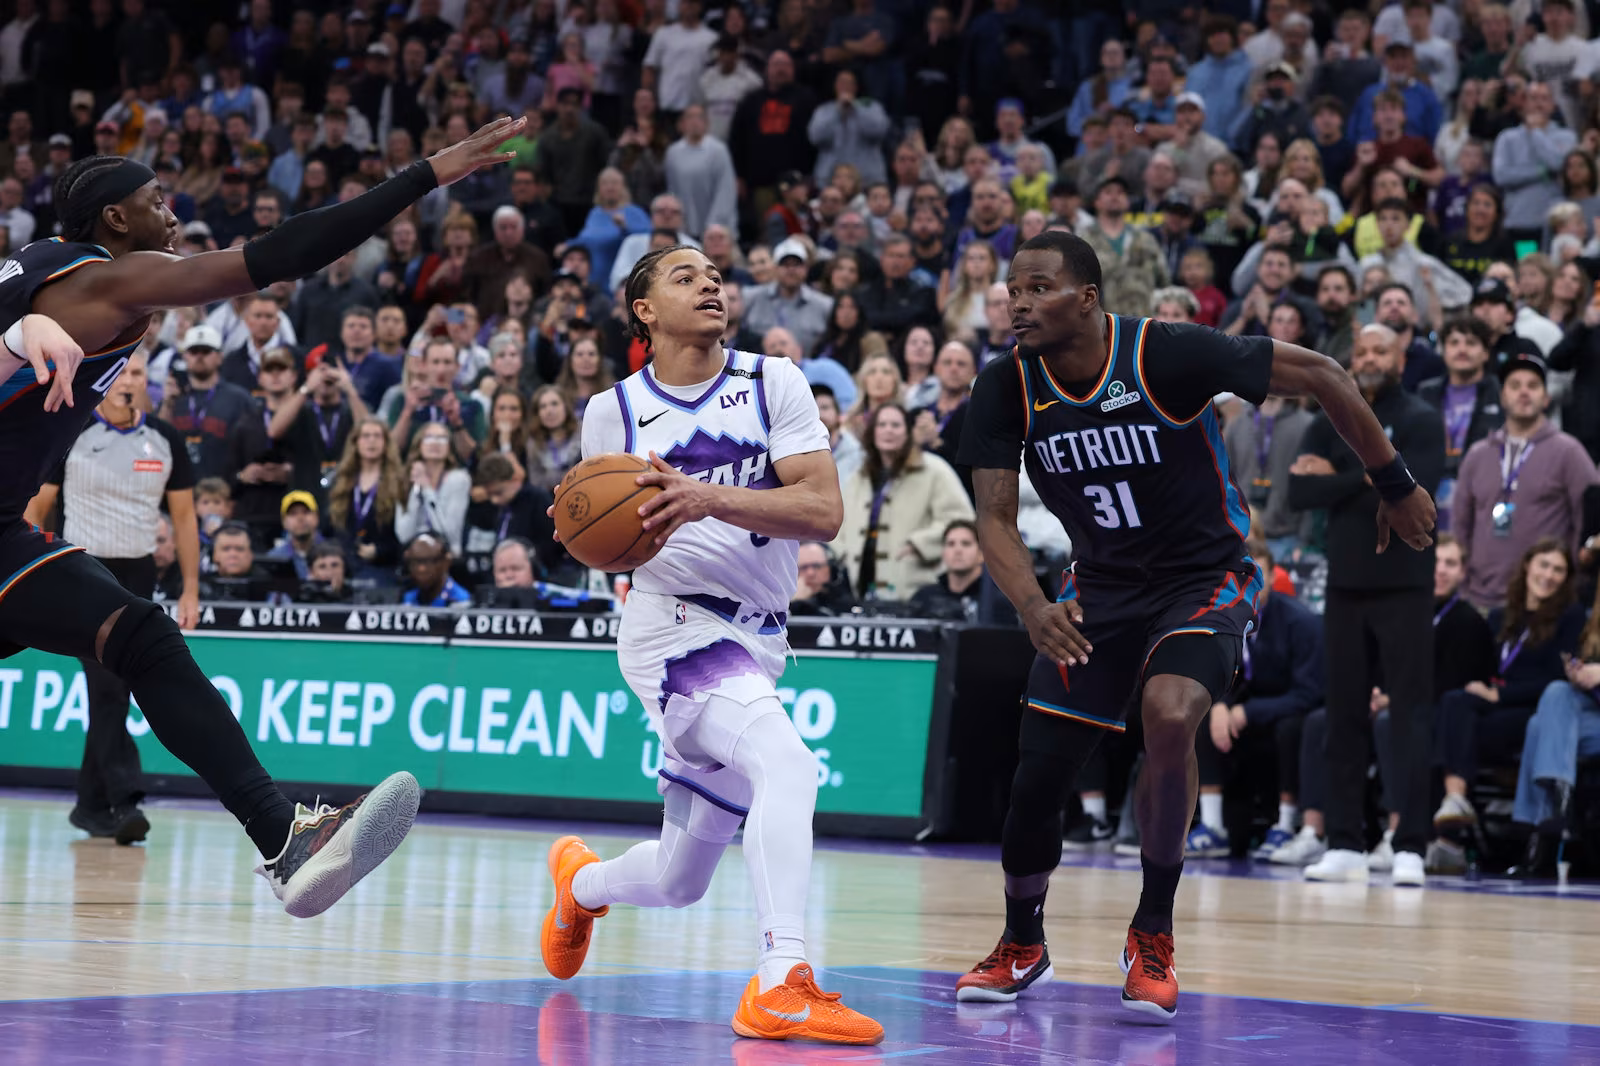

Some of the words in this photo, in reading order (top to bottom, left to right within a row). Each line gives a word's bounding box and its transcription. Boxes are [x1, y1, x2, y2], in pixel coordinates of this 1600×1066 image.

[720, 390, 749, 409] LVT
[1102, 392, 1139, 411] StockX
[1033, 424, 1162, 474] DETROIT
[675, 452, 768, 488] AH
[1083, 480, 1142, 529] 31
[258, 607, 321, 627] DELTA
[365, 611, 430, 631] DELTA
[476, 615, 543, 635] DELTA
[841, 626, 916, 648] DELTA
[257, 678, 396, 747] KEEP
